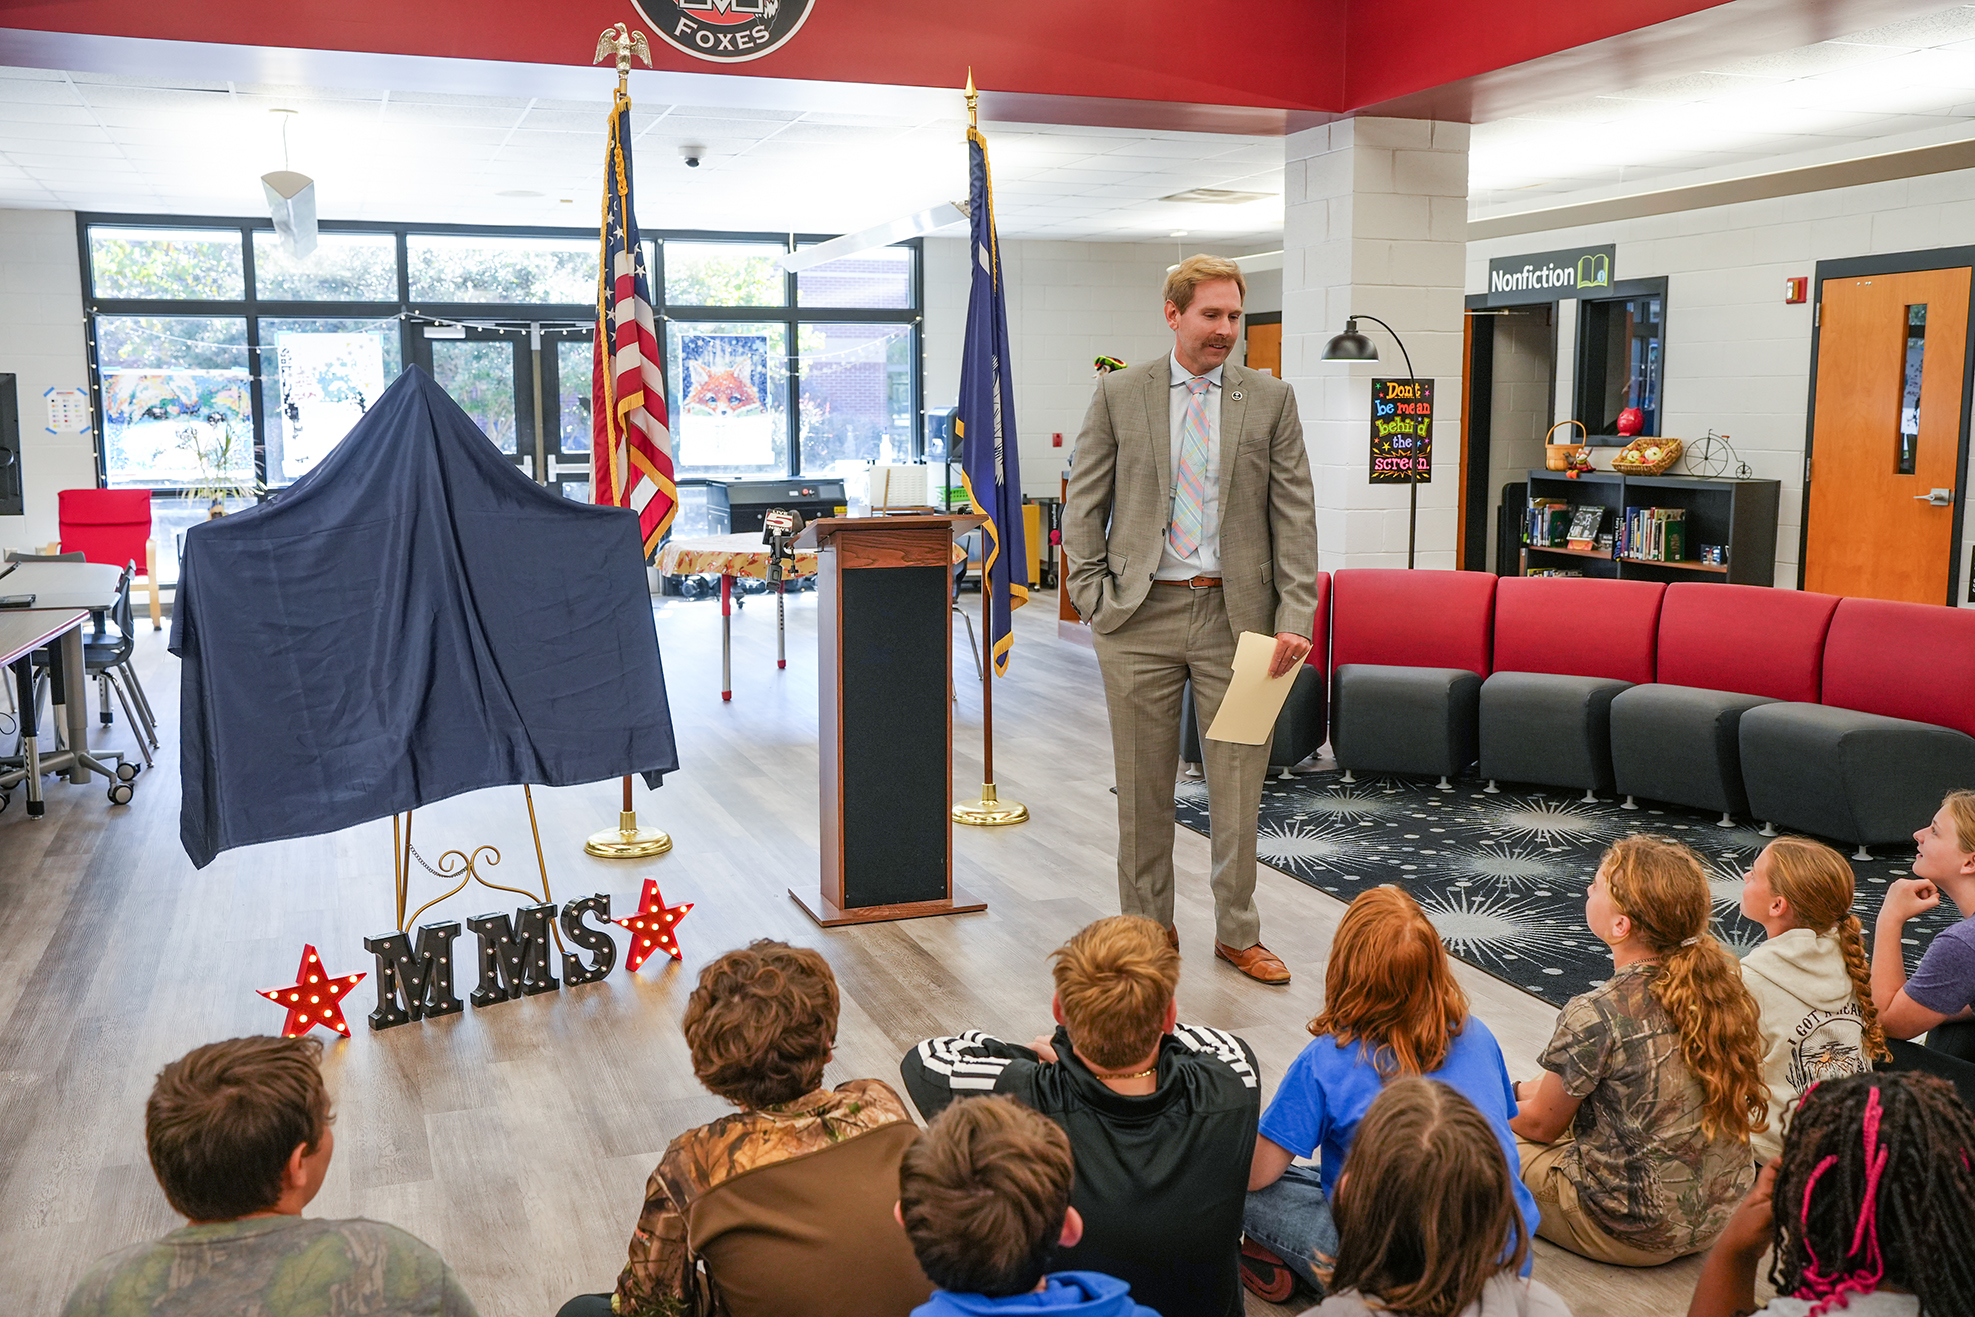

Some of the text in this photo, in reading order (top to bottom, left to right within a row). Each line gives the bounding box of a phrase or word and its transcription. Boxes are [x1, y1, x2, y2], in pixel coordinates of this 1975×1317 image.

[674, 16, 770, 51] FOXES
[1491, 263, 1575, 293] Nonfiction
[1386, 382, 1421, 399] Don't
[1375, 399, 1430, 416] be mean
[1392, 434, 1413, 448] the
[768, 524, 790, 532] NWS
[364, 893, 617, 1030] MMS
[1795, 1009, 1821, 1037] GOT
